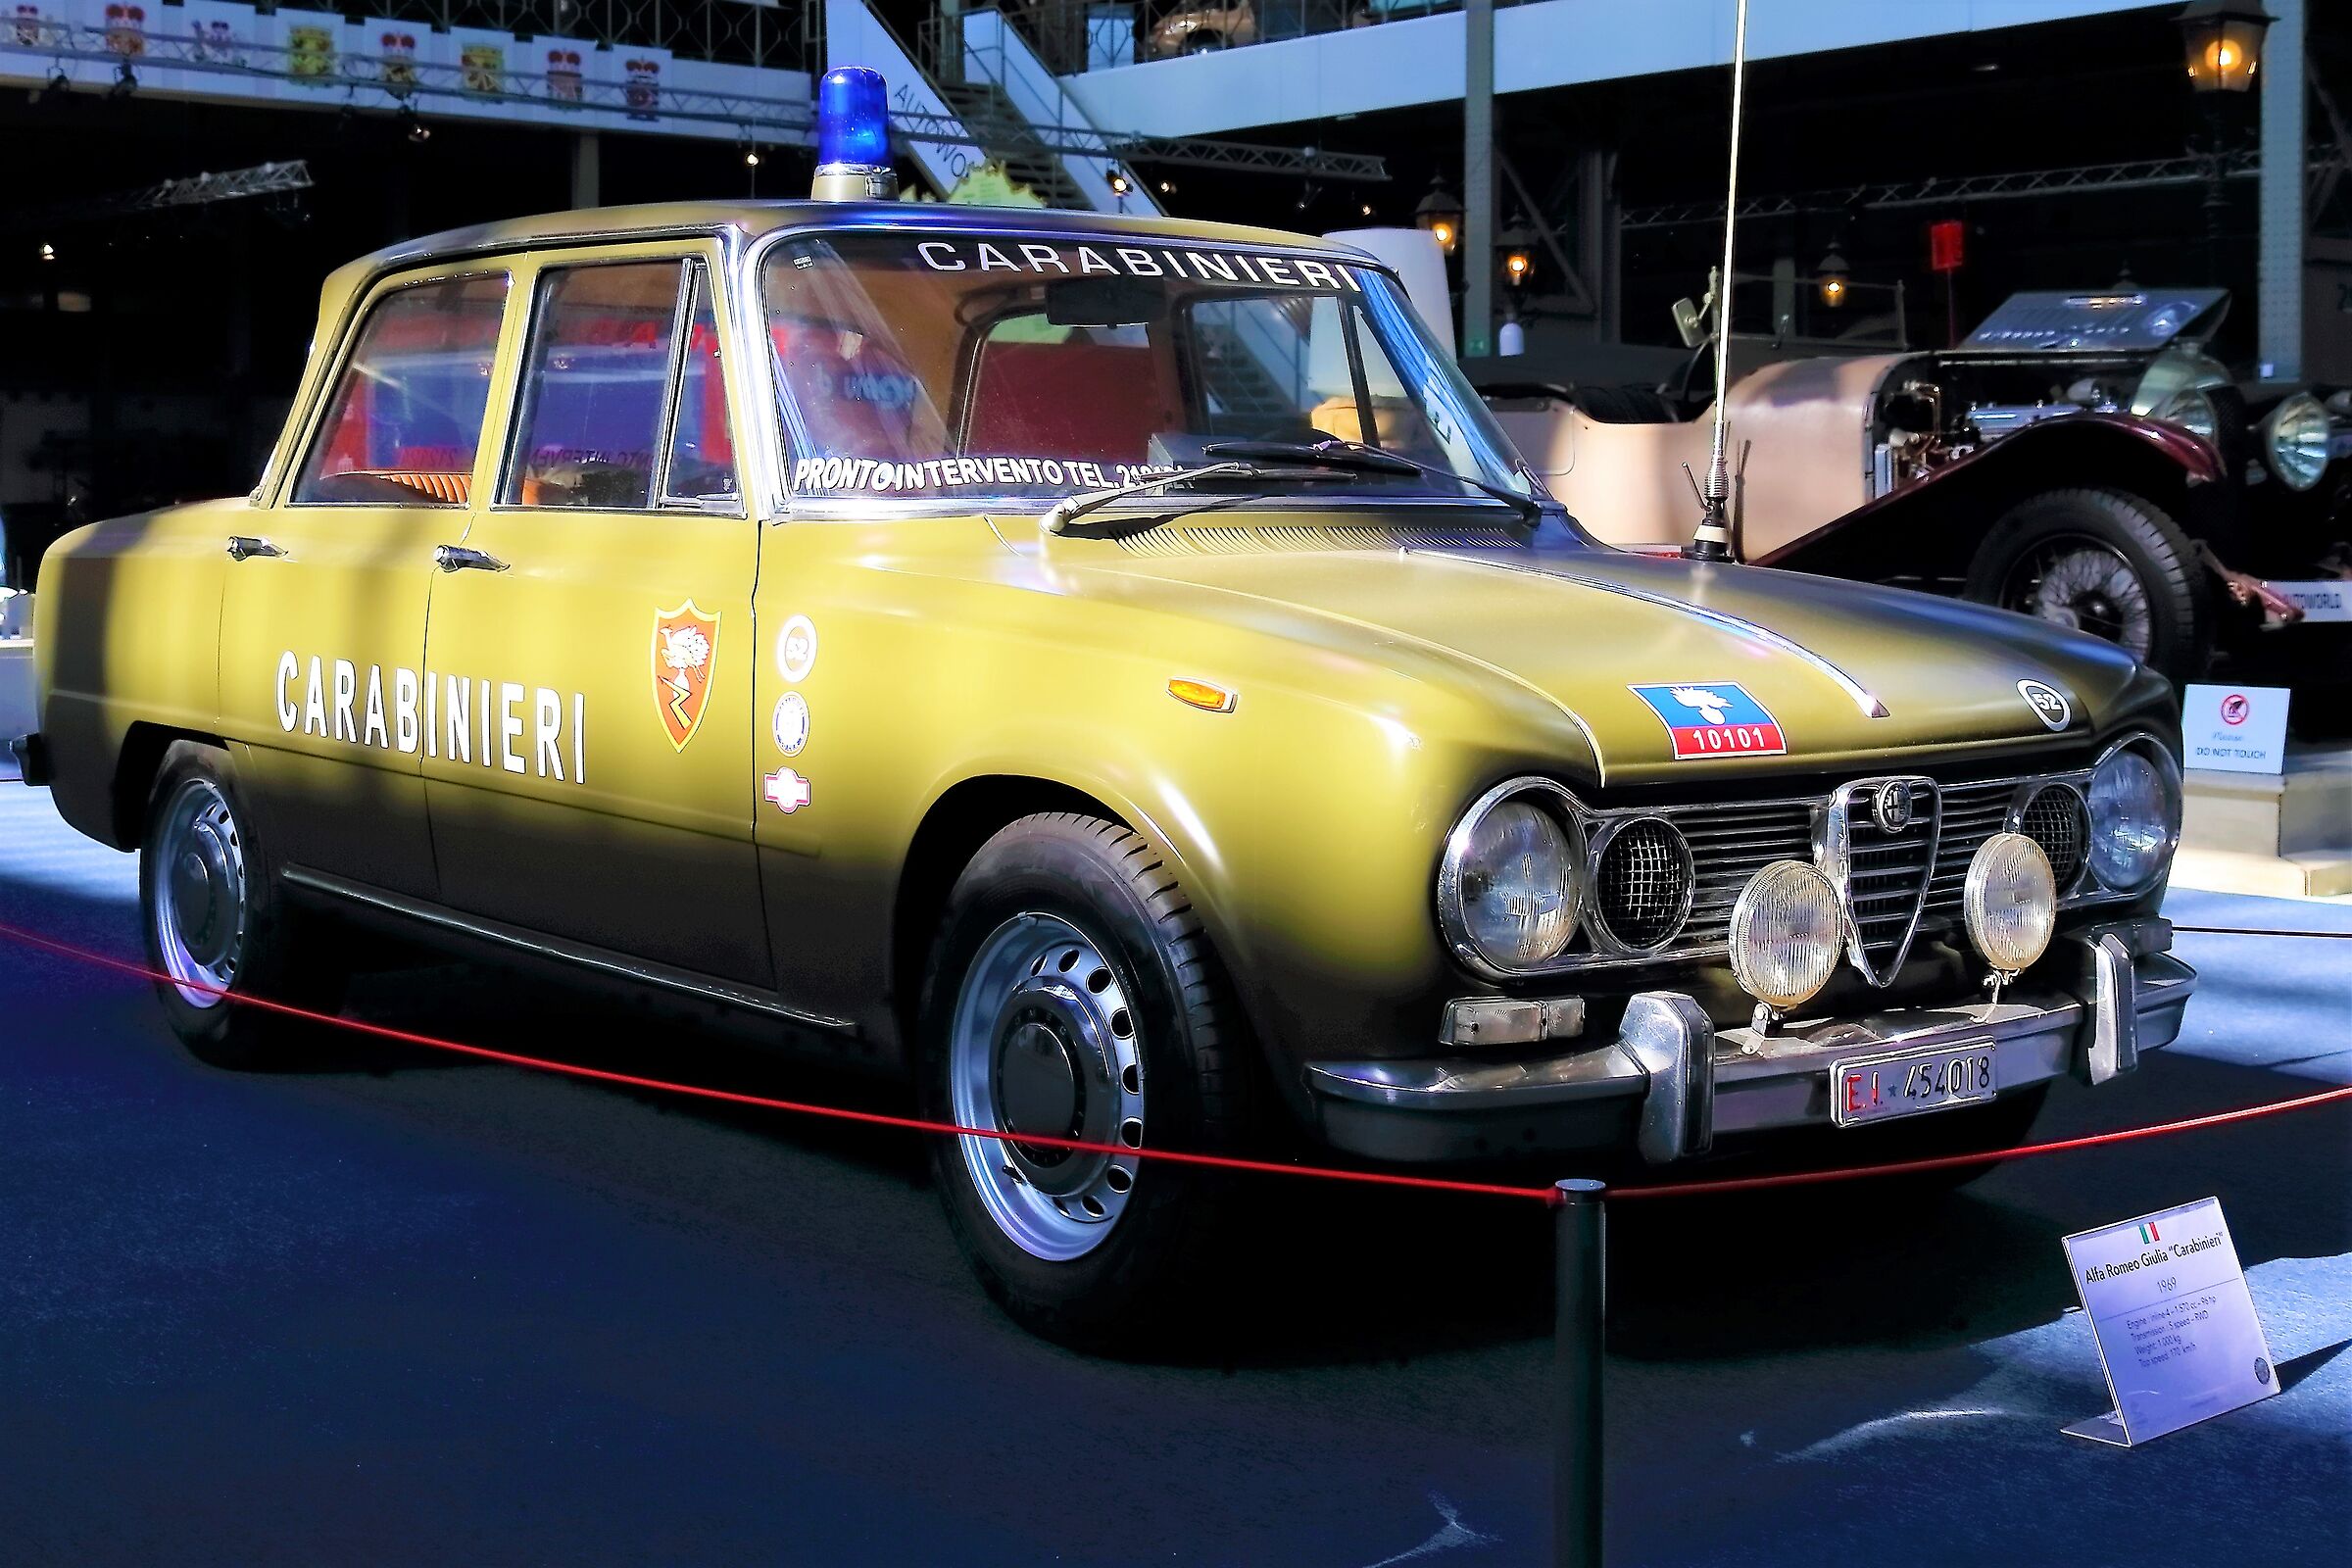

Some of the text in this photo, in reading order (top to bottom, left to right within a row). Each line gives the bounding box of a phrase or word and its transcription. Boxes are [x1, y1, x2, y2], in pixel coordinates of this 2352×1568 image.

[917, 241, 1361, 293] CARABINIERI
[2032, 692, 2063, 711] 52
[276, 650, 585, 785] CARABINIERI
[1692, 726, 1766, 752] 10101
[2196, 747, 2267, 760] DO NOT TOUCH
[1903, 1055, 1990, 1100] 454018
[2084, 1266, 2106, 1284] Alfa
[2106, 1259, 2140, 1278] Romeo
[2140, 1250, 2169, 1267] Giulia
[2156, 1276, 2178, 1294] 1969
